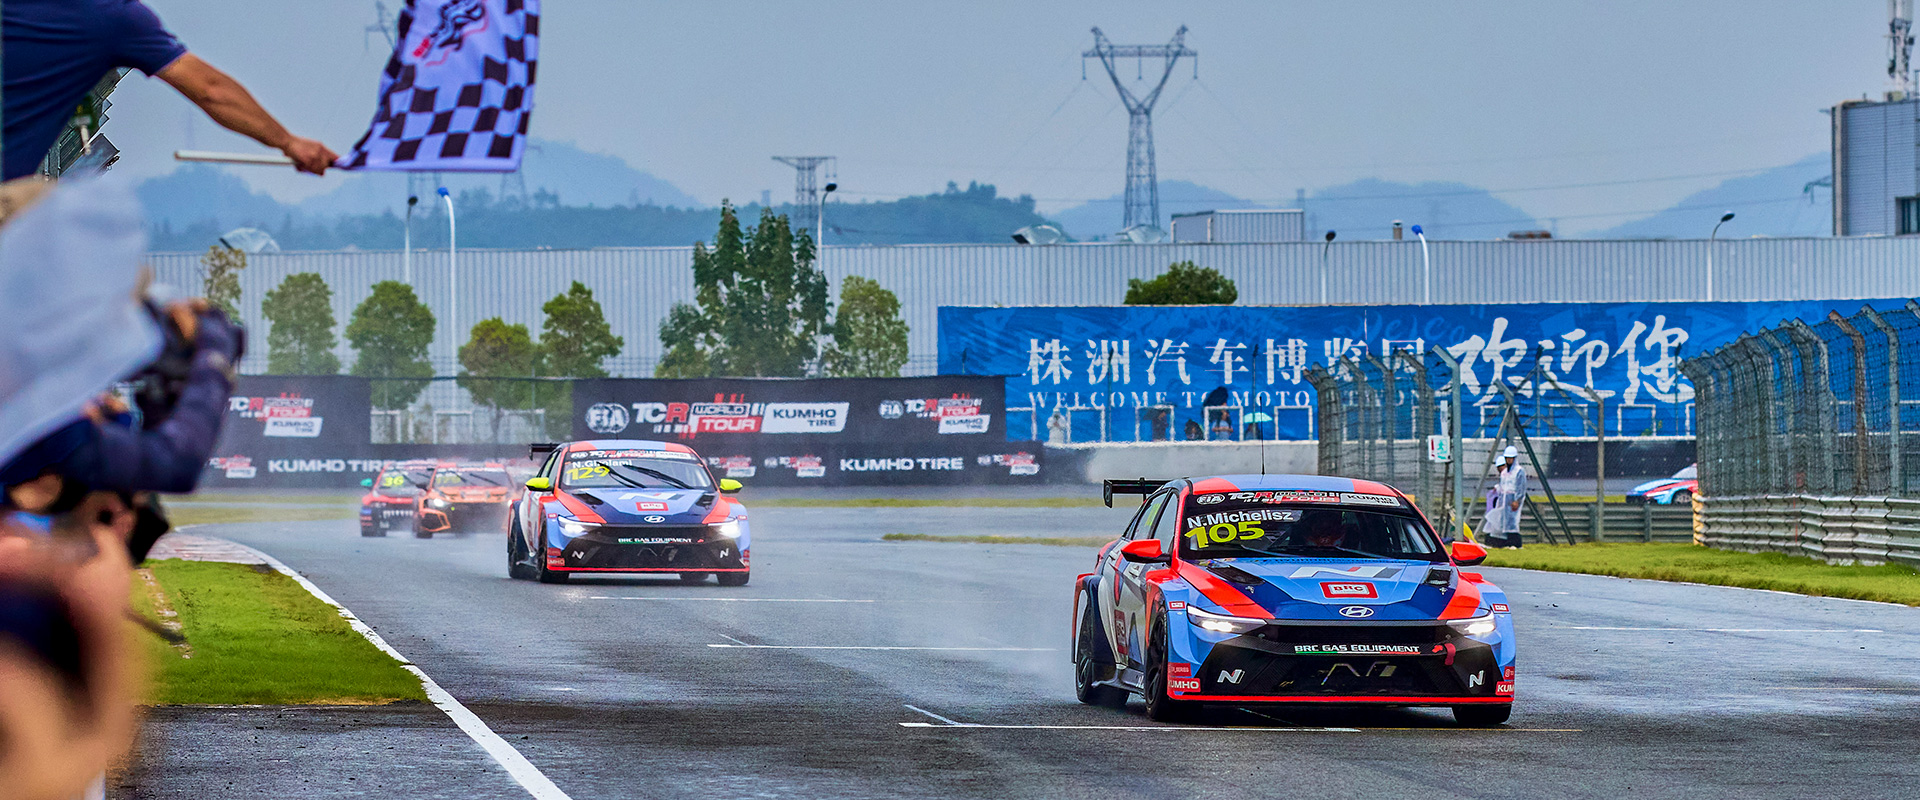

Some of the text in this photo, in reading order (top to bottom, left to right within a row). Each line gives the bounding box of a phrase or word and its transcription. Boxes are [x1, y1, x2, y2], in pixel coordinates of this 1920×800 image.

[1436, 314, 1697, 407] 欢迎您
[1029, 391, 1168, 408] WELCOME
[1232, 391, 1310, 408] MOTO
[773, 408, 837, 419] KUMHO
[880, 401, 902, 417] FIA
[904, 399, 938, 413] TCR
[588, 402, 745, 430] FIA TCR WORLD
[702, 419, 756, 430] TOUR
[808, 419, 837, 427] TIRE
[268, 459, 346, 472] KUMHO
[840, 457, 964, 471] KUMHO TIRE
[566, 466, 610, 480] 129
[382, 475, 404, 487] 36
[1198, 494, 1223, 504] FIA
[1228, 492, 1273, 500] TCR
[1346, 495, 1392, 503] KUMHO
[1187, 510, 1294, 529] N.Michelisz
[1184, 521, 1265, 549] 105
[1351, 645, 1420, 653] EQUIPMENT
